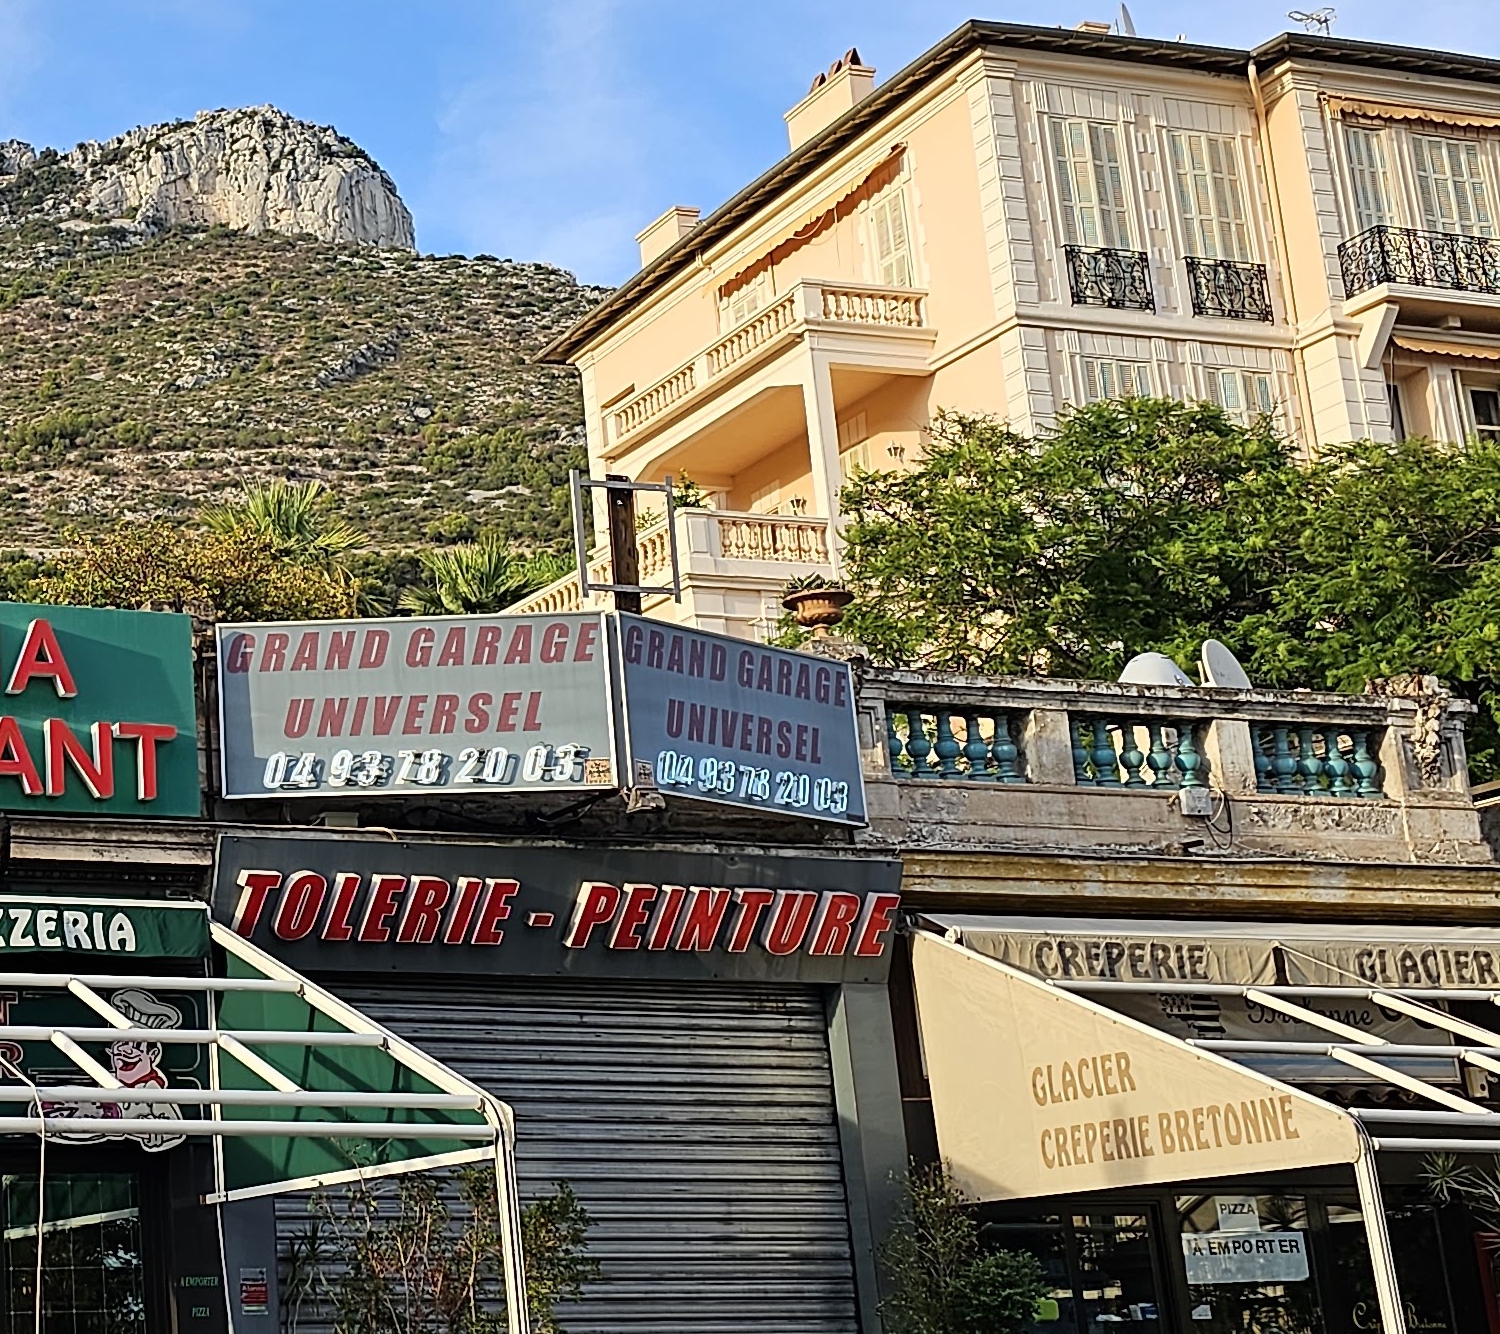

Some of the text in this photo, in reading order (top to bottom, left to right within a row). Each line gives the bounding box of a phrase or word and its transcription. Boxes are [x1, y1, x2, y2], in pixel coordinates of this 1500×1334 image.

[226, 622, 598, 674] GRAND GARAGE
[624, 623, 848, 709] GRAND GARAGE
[283, 692, 544, 739] UNIVERSEL
[666, 698, 823, 766] UNIVERSEL
[263, 751, 318, 788] 04
[328, 750, 383, 786] 93
[395, 748, 444, 785] 78
[454, 747, 509, 783] 20
[523, 742, 580, 782] 03
[657, 751, 695, 788] 04
[697, 757, 736, 795] 93
[738, 764, 771, 801] 78
[774, 771, 810, 808] 20
[813, 778, 849, 814] 03
[232, 869, 521, 946] TOLERIE
[562, 882, 902, 959] PEINTURE
[1035, 940, 1499, 986] CREPERIE GLACIER
[1032, 1051, 1138, 1107] GLACIER
[1040, 1094, 1301, 1170] CREPERIE BRETONNE
[1220, 1202, 1256, 1216] PIZZA
